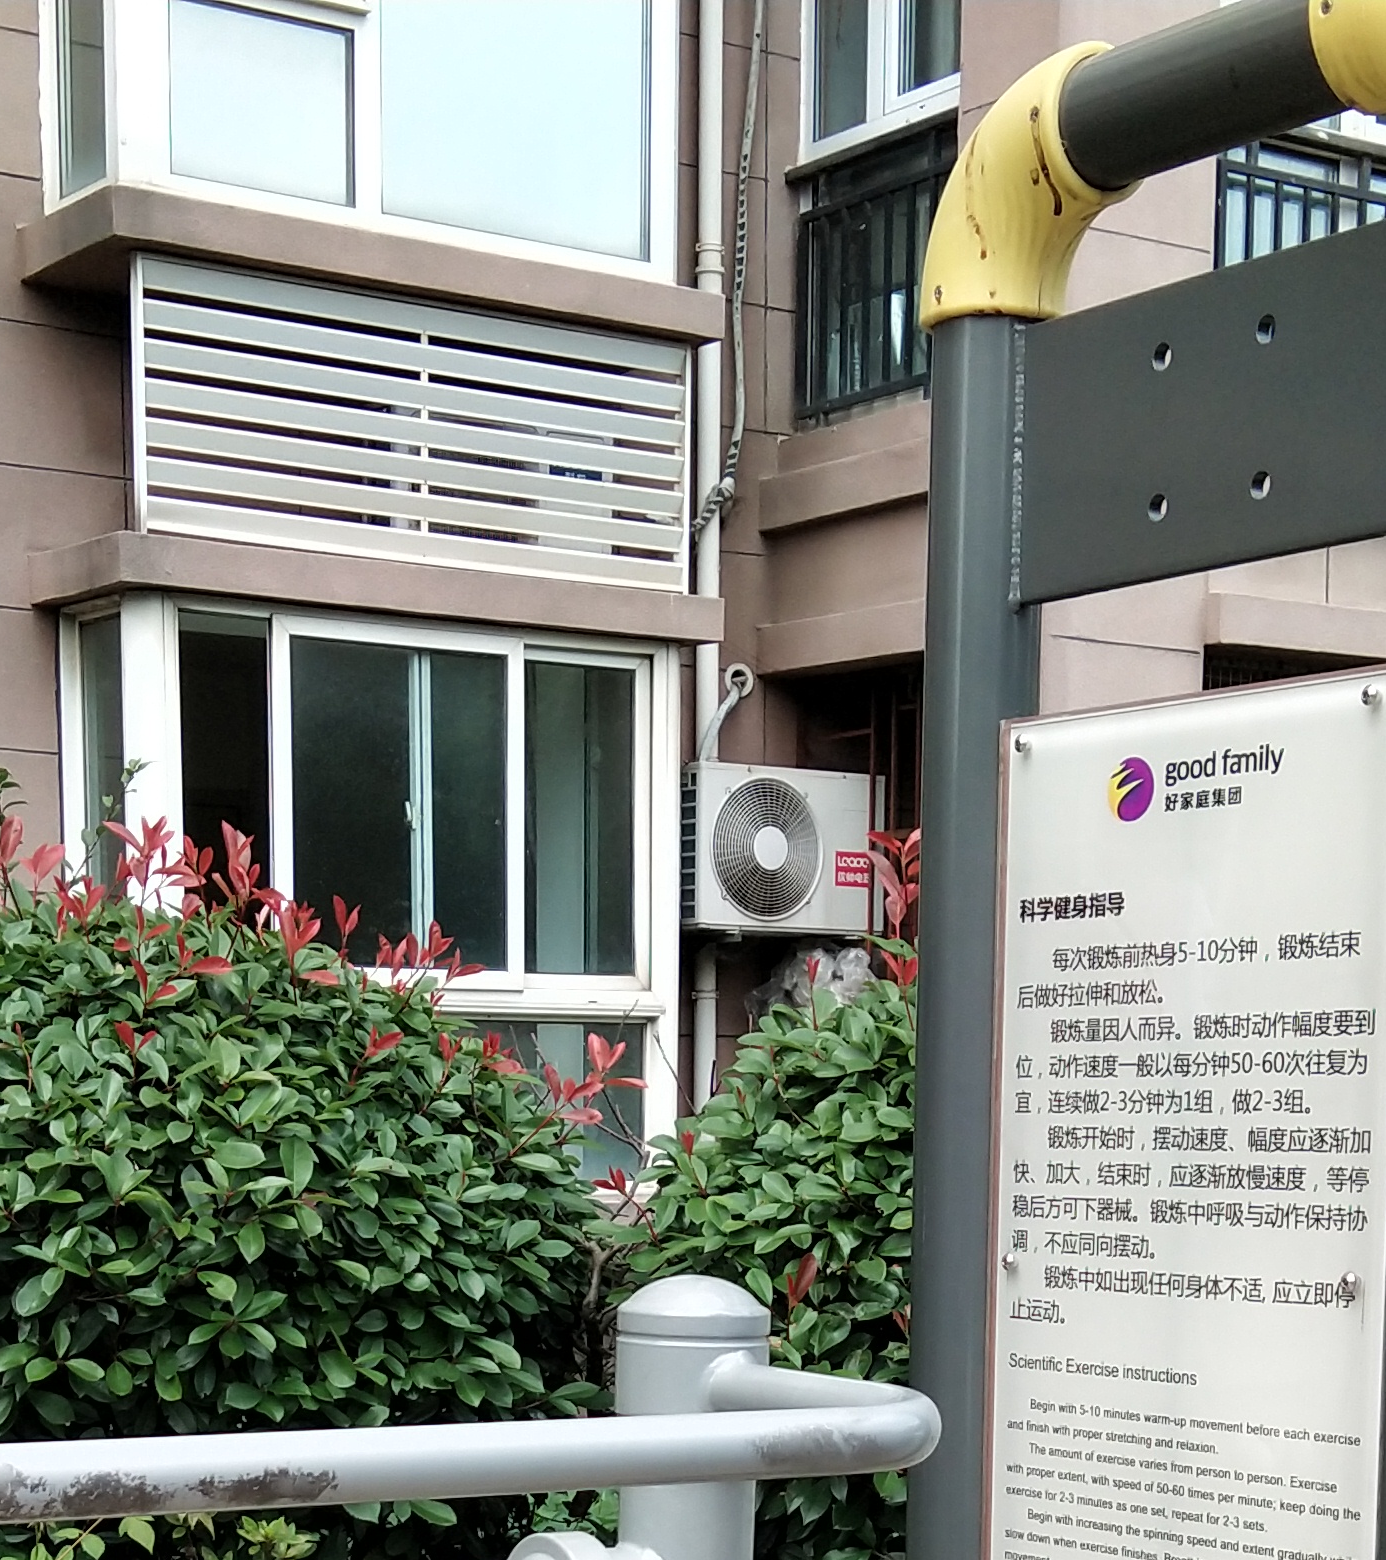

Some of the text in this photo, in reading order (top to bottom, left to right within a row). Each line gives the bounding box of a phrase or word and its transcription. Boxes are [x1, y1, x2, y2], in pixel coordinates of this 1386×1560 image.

[1165, 743, 1284, 787] good family
[1165, 786, 1242, 812] 好家庭集团
[1019, 892, 1125, 923] 科学健身指导
[1017, 980, 1163, 1009] 后做好拉伸和放松。
[1010, 1299, 1066, 1324] 止运动。
[1009, 1353, 1197, 1385] Scientific Exercise instructions
[1007, 1419, 1023, 1431] and
[1026, 1420, 1049, 1434] finish
[1052, 1424, 1070, 1436] with
[1073, 1428, 1104, 1440] proper
[1105, 1431, 1152, 1449] stretching
[1154, 1437, 1173, 1449] and
[1030, 1398, 1361, 1446] Begin with 5-10 minutes warm-up movement before each exercise
[1029, 1442, 1046, 1455] The
[1049, 1447, 1082, 1461] amount
[1085, 1450, 1096, 1461] of
[1097, 1453, 1136, 1467] exercise
[1139, 1458, 1168, 1472] varies
[1171, 1461, 1193, 1475] from
[1196, 1466, 1231, 1480] person
[1234, 1469, 1244, 1481] to
[1290, 1475, 1338, 1493] Exercise
[1006, 1463, 1024, 1475] with
[1026, 1467, 1056, 1480] proper
[1091, 1475, 1109, 1486] with
[1113, 1478, 1141, 1491] speed
[1144, 1482, 1154, 1493] of
[1156, 1482, 1184, 1497] 50-60
[1188, 1487, 1214, 1501] times
[1218, 1491, 1234, 1504] per
[1279, 1501, 1306, 1515] keep
[1309, 1504, 1339, 1521] doing
[1343, 1507, 1361, 1521] the
[1006, 1485, 1042, 1499] exercise
[1045, 1488, 1057, 1500] for
[1060, 1491, 1074, 1504] 2-3
[1077, 1495, 1113, 1510] minutes
[1116, 1502, 1127, 1512] as
[1130, 1504, 1148, 1515] one
[1171, 1509, 1203, 1523] repeat
[1206, 1512, 1220, 1525] for
[1223, 1515, 1239, 1528] 2-3
[1005, 1528, 1024, 1540] slow
[1027, 1531, 1050, 1544] down
[1053, 1537, 1077, 1549] when
[1080, 1541, 1119, 1555] exercise
[1027, 1508, 1052, 1524] Begin
[1055, 1514, 1073, 1525] with
[1076, 1516, 1123, 1536] increasing
[1126, 1524, 1140, 1536] the
[1143, 1528, 1183, 1545] spinning
[1187, 1535, 1217, 1548] speed
[1220, 1539, 1239, 1551] and
[1242, 1544, 1274, 1557] extent
